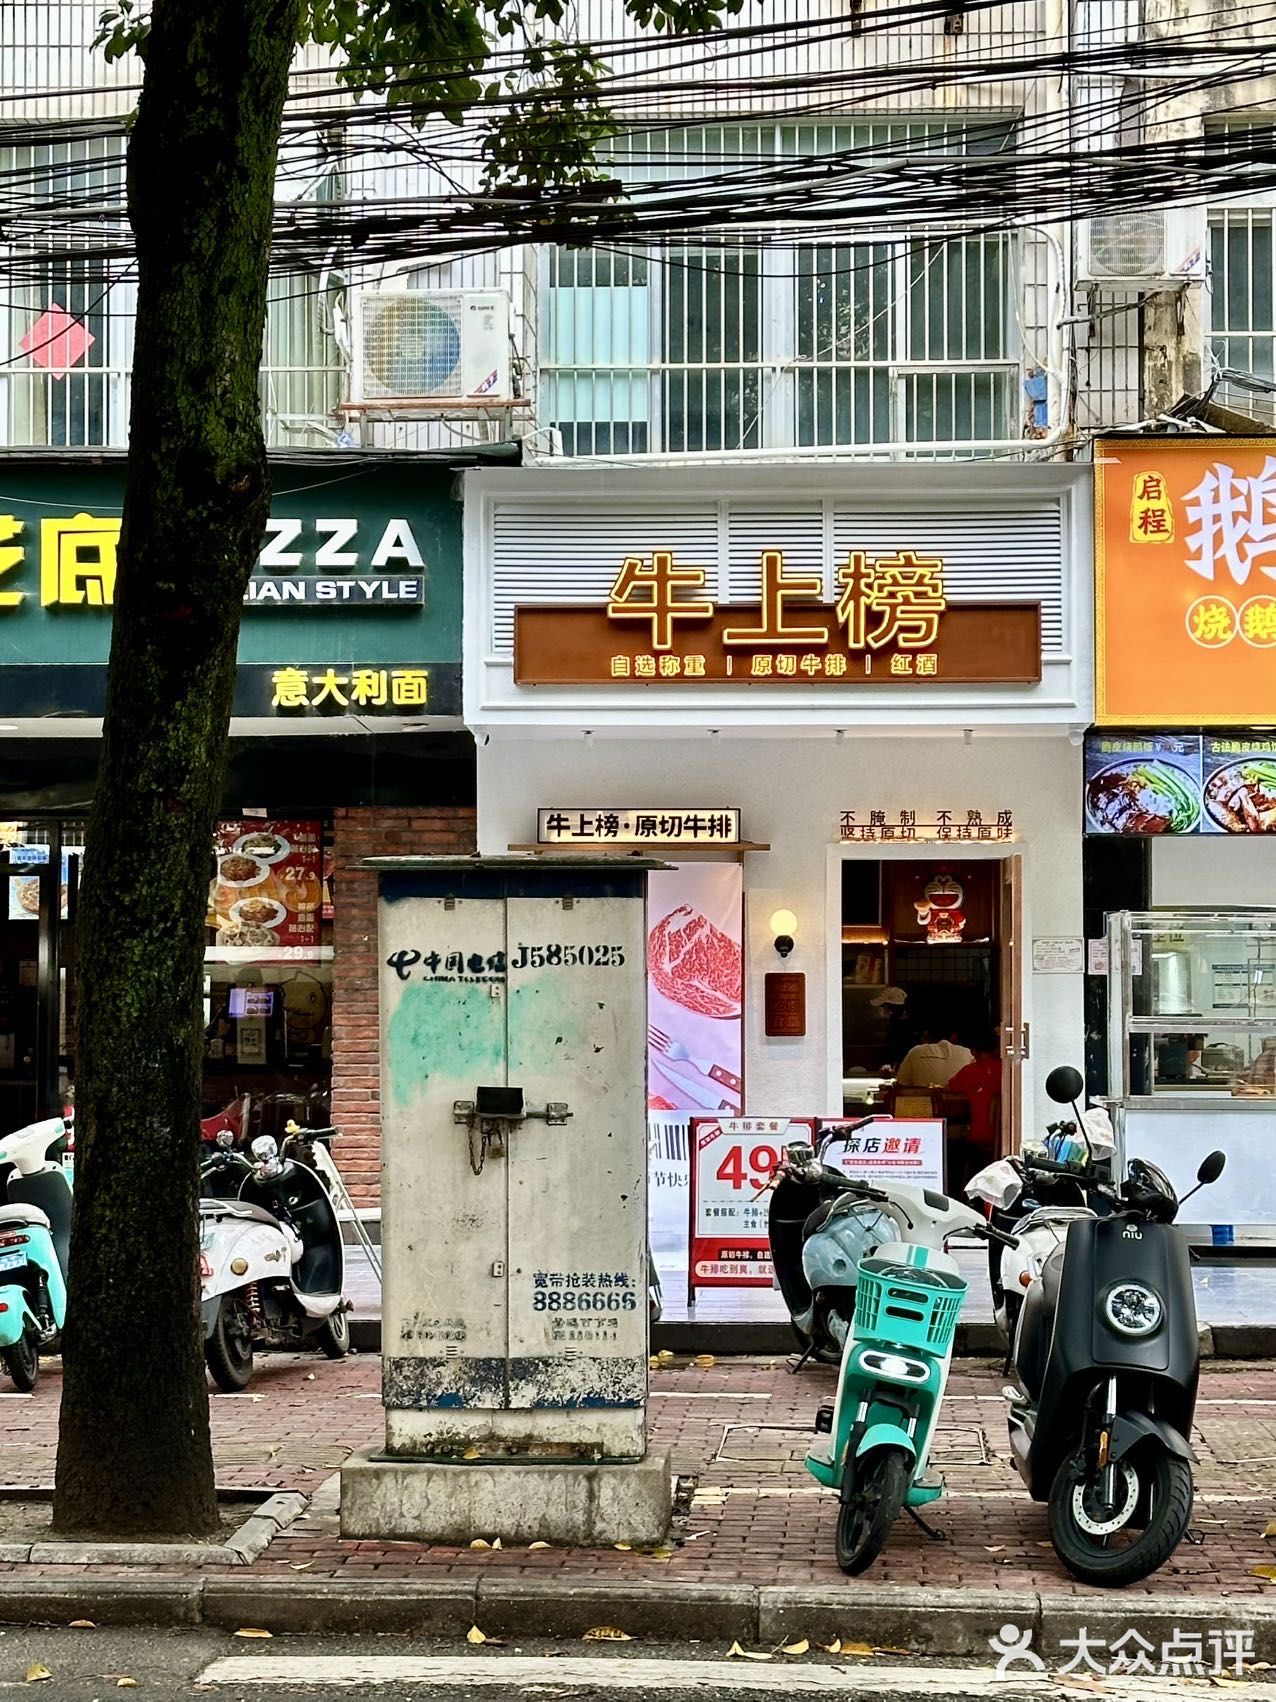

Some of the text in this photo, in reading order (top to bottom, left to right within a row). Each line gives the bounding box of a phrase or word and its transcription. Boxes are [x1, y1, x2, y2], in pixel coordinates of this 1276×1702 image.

[1138, 475, 1169, 535] 启程
[243, 580, 418, 600] IAN STYLE
[606, 550, 947, 651] 牛上榜
[610, 654, 939, 677] 自选称重 原切牛排 红酒
[271, 666, 429, 707] 意大利面
[839, 809, 1013, 826] 不腌制 不熟成
[839, 827, 1013, 841] 坚持原切 保持原味
[511, 944, 626, 969] J585025
[842, 1137, 922, 1154] 探店邀请
